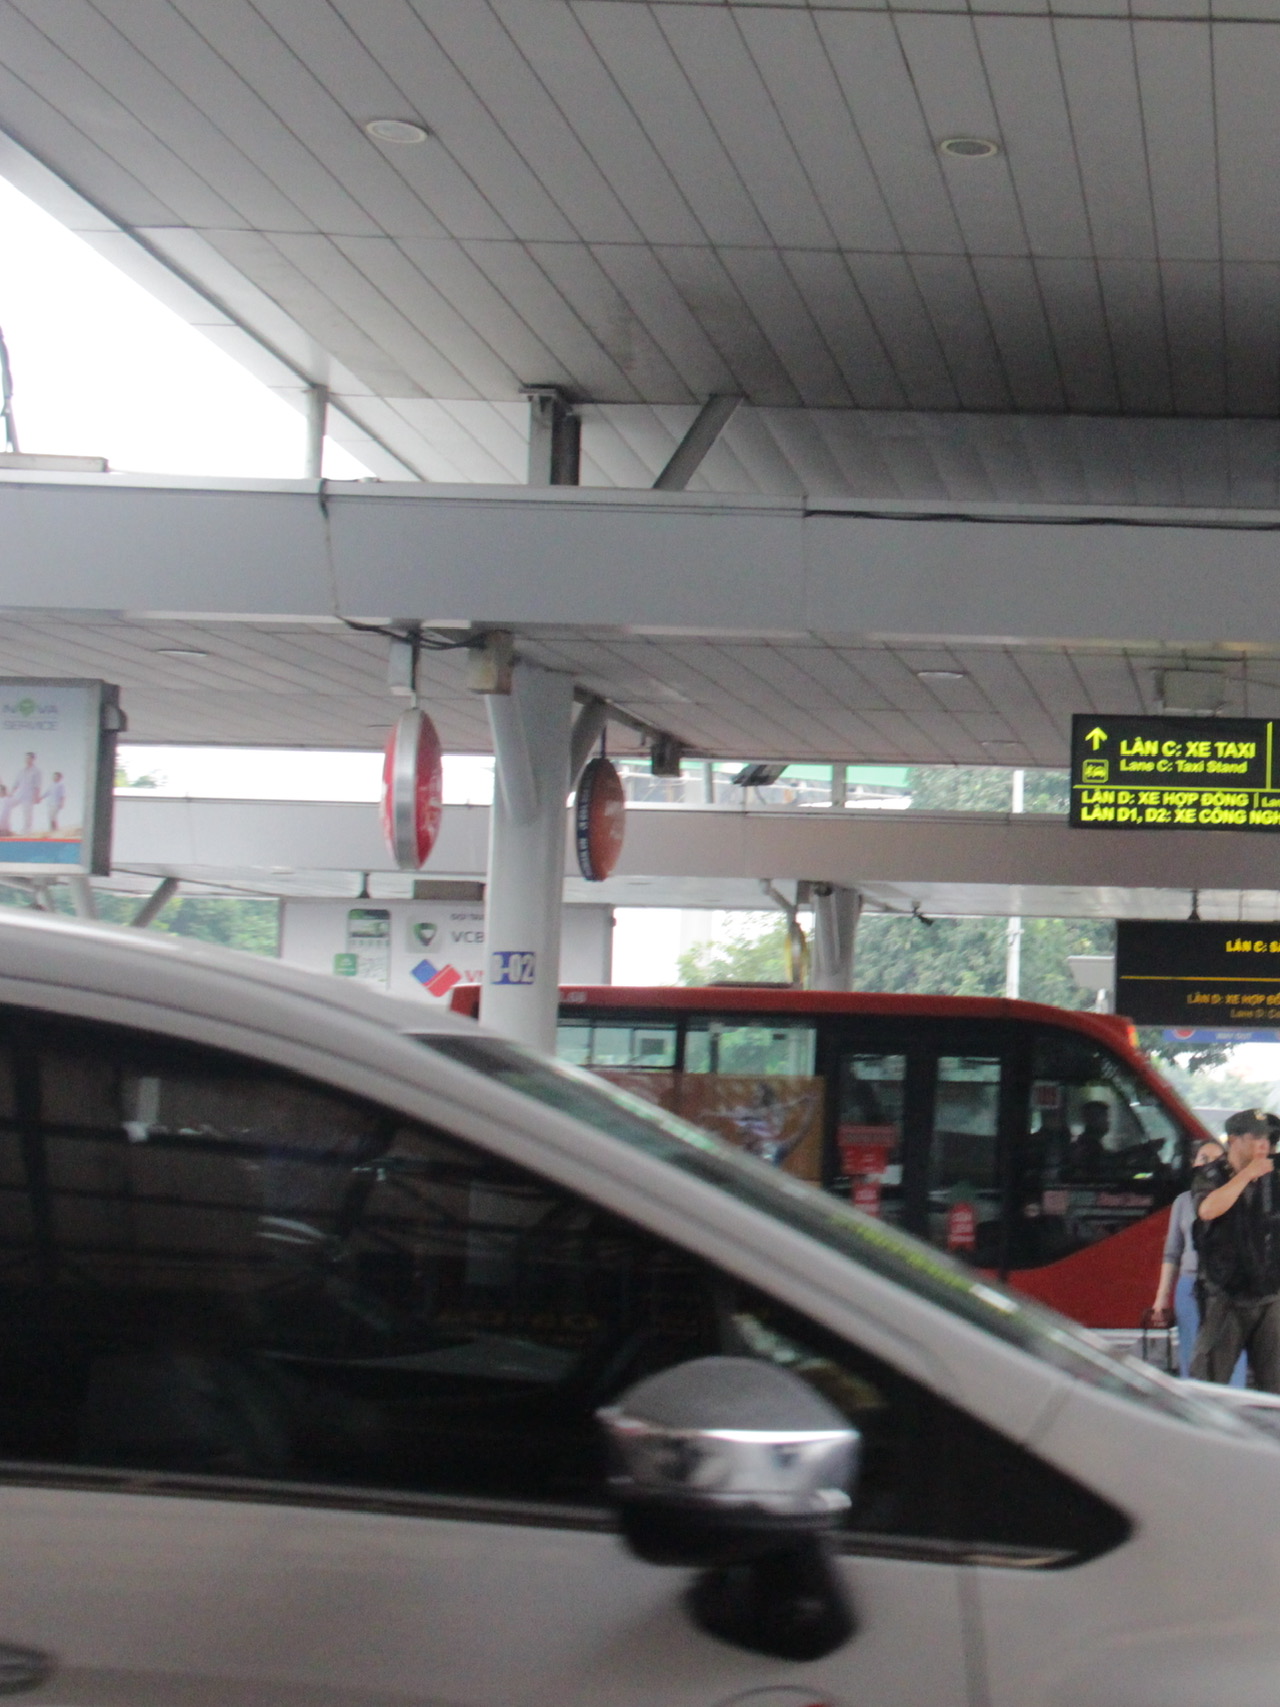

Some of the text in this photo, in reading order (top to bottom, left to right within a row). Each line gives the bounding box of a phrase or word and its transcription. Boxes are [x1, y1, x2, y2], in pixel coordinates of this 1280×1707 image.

[1162, 741, 1182, 757] C:
[1186, 741, 1211, 758] XE
[1215, 742, 1256, 759] TAXI
[1119, 759, 1248, 774] Lane C: Taxi Stand
[1137, 791, 1160, 805] XE
[1174, 808, 1196, 823] XE
